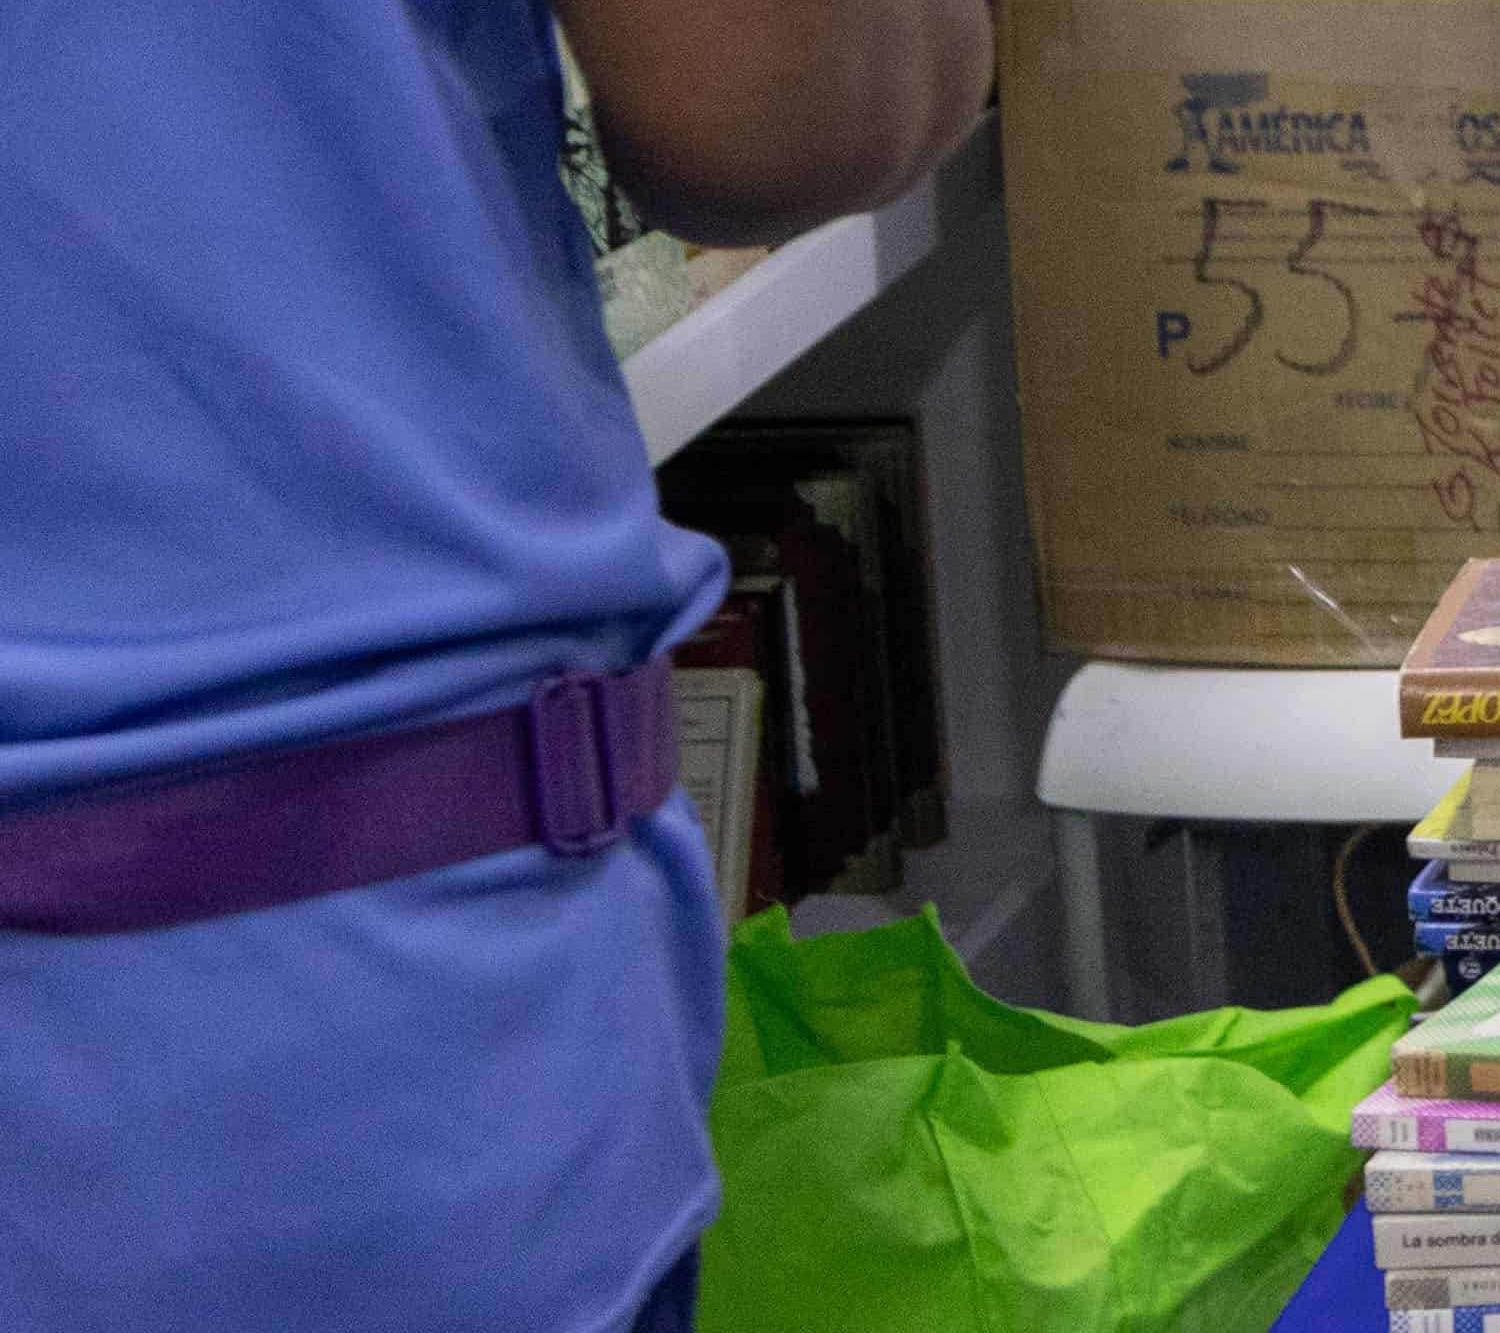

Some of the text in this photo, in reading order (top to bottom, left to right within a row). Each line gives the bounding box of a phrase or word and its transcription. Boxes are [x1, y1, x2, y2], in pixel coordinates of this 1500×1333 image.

[1157, 312, 1191, 357] P
[1402, 1233, 1421, 1248] La
[1424, 1229, 1488, 1248] sombra
